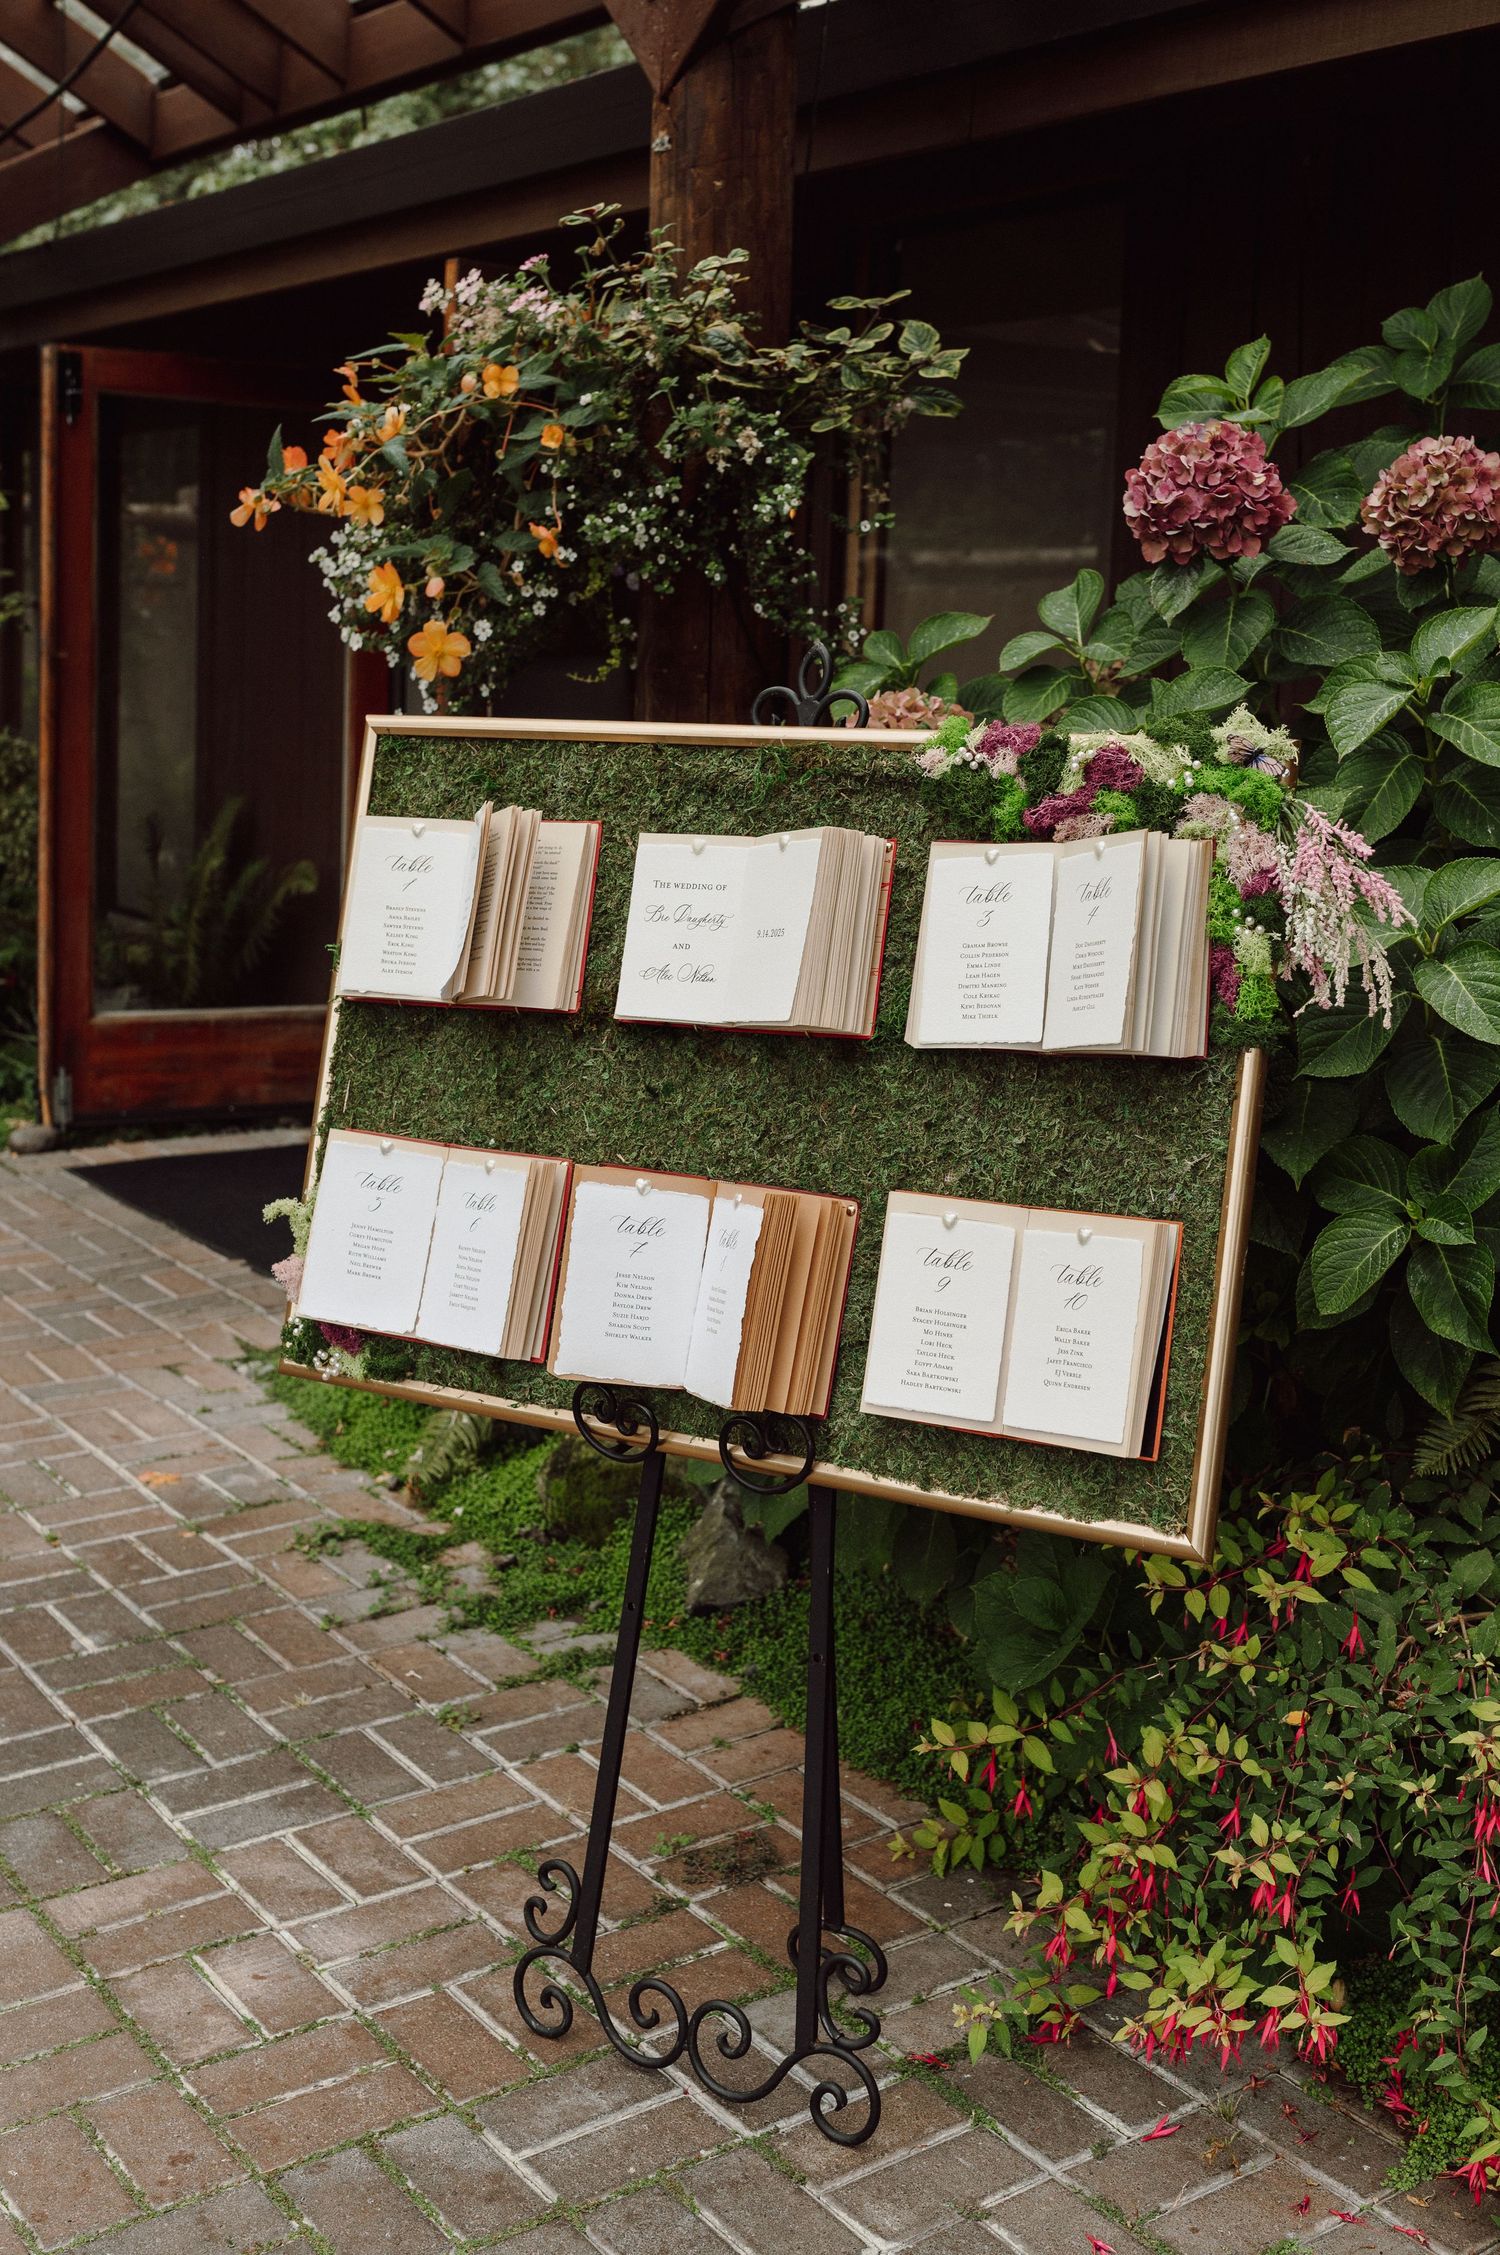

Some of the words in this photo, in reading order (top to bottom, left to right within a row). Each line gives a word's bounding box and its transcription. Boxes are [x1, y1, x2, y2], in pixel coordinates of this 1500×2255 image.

[385, 855, 434, 873] table
[402, 878, 417, 892] 1
[653, 879, 671, 889] THE
[673, 882, 713, 890] WEDDING
[715, 883, 728, 891] OF
[1077, 876, 1112, 902] table
[959, 881, 1014, 904] table
[643, 904, 670, 923] Bre
[673, 903, 735, 931] Daugherty
[976, 910, 994, 927] 3
[1086, 905, 1099, 925] 4
[756, 928, 785, 938] 9.14.2025
[639, 962, 674, 984] Alec
[676, 963, 717, 984] Nelson
[355, 1171, 404, 1193] table
[367, 1196, 384, 1212] 5
[463, 1191, 496, 1213] table
[469, 1217, 480, 1232] 6
[608, 1214, 667, 1237] table
[628, 1241, 648, 1258] 7
[916, 1247, 974, 1272] table
[614, 1271, 631, 1279] JESSE
[632, 1273, 655, 1281] NELSON
[1050, 1264, 1105, 1288] table
[934, 1276, 951, 1293] 9
[614, 1291, 635, 1299] DONNA
[636, 1293, 653, 1301] DREW
[1063, 1292, 1088, 1310] 10
[612, 1301, 634, 1309] BAYLOR
[635, 1303, 652, 1311] DREW
[915, 1306, 932, 1314] BRIAN
[934, 1308, 967, 1319] HOLSINGER
[612, 1311, 628, 1319] SUZIE
[608, 1321, 631, 1329] SHARON
[912, 1316, 933, 1325] STACEY
[934, 1319, 967, 1329] HOLSINGER
[604, 1331, 628, 1339] SHIRLEY
[934, 1330, 953, 1338] HINES
[1056, 1325, 1072, 1333] ERICA
[1073, 1327, 1091, 1335] BAKER
[920, 1339, 934, 1347] LORI
[936, 1341, 952, 1349] HECK
[1054, 1336, 1071, 1344] WALLY
[1072, 1338, 1090, 1346] BAKER
[916, 1349, 937, 1358] TAYLOR
[938, 1351, 955, 1360] HECK
[1057, 1347, 1069, 1355] JESS
[1070, 1349, 1083, 1357] ZINK
[914, 1359, 933, 1368] EGYPT
[934, 1362, 953, 1371] ADAMS
[1063, 1359, 1092, 1369] FRANCISCO
[906, 1369, 920, 1377] SARA
[922, 1371, 959, 1382] BARTKOWSKI
[1054, 1369, 1061, 1378] EJ
[900, 1379, 923, 1388] HADLEY
[924, 1382, 961, 1394] BARTKOWSKI
[1043, 1379, 1062, 1387] QUINN
[1063, 1381, 1090, 1391] ENDRESEN
